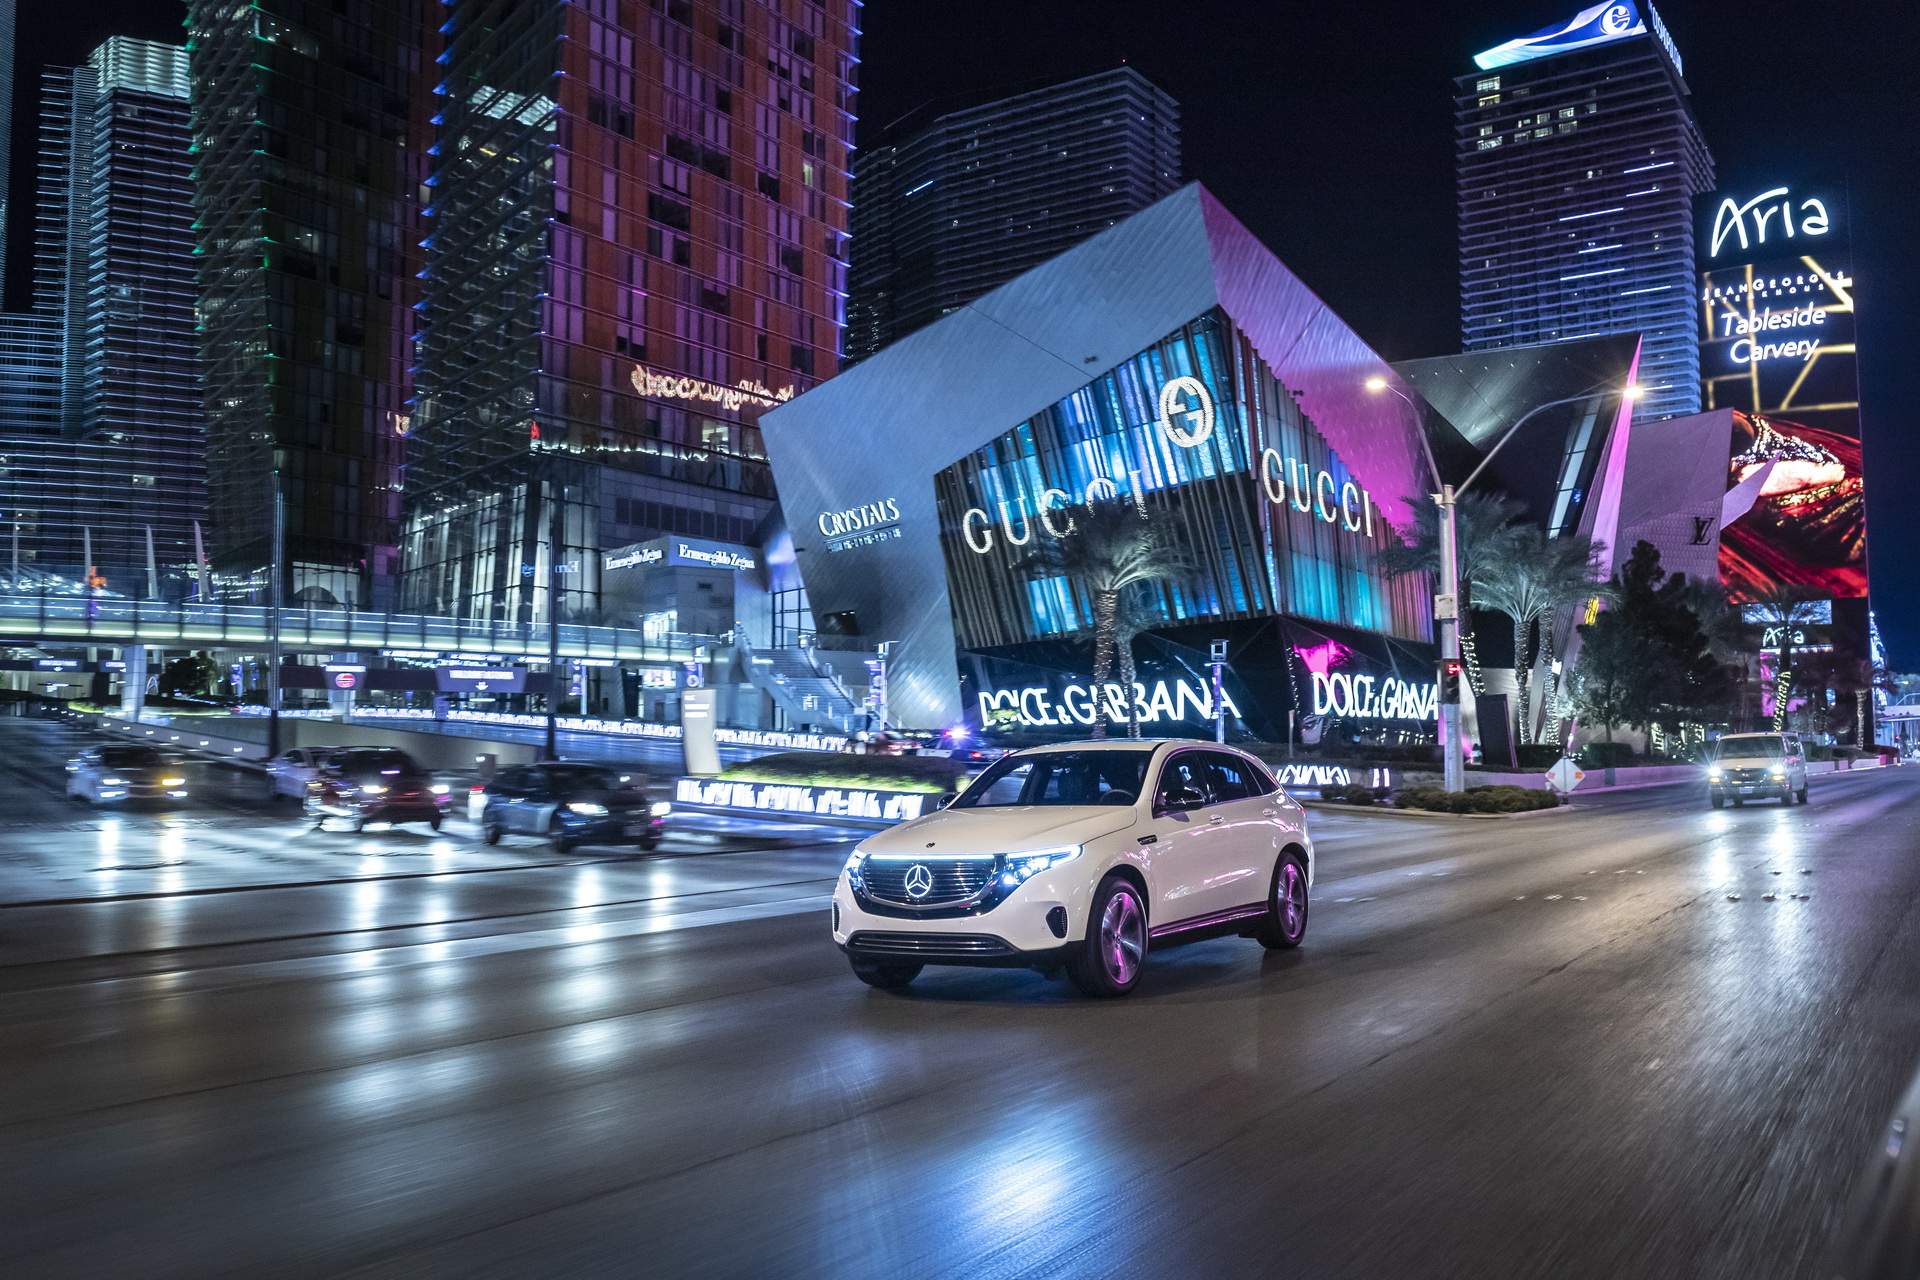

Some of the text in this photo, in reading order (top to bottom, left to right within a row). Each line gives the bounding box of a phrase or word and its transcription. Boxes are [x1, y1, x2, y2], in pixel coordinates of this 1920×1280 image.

[1711, 186, 1829, 257] Aria
[1709, 283, 1824, 307] STEAKHOUS
[1721, 301, 1826, 336] Tableside
[1730, 338, 1820, 363] Carvery
[1262, 448, 1374, 537] GUCCI
[818, 498, 900, 536] CRYSTALS
